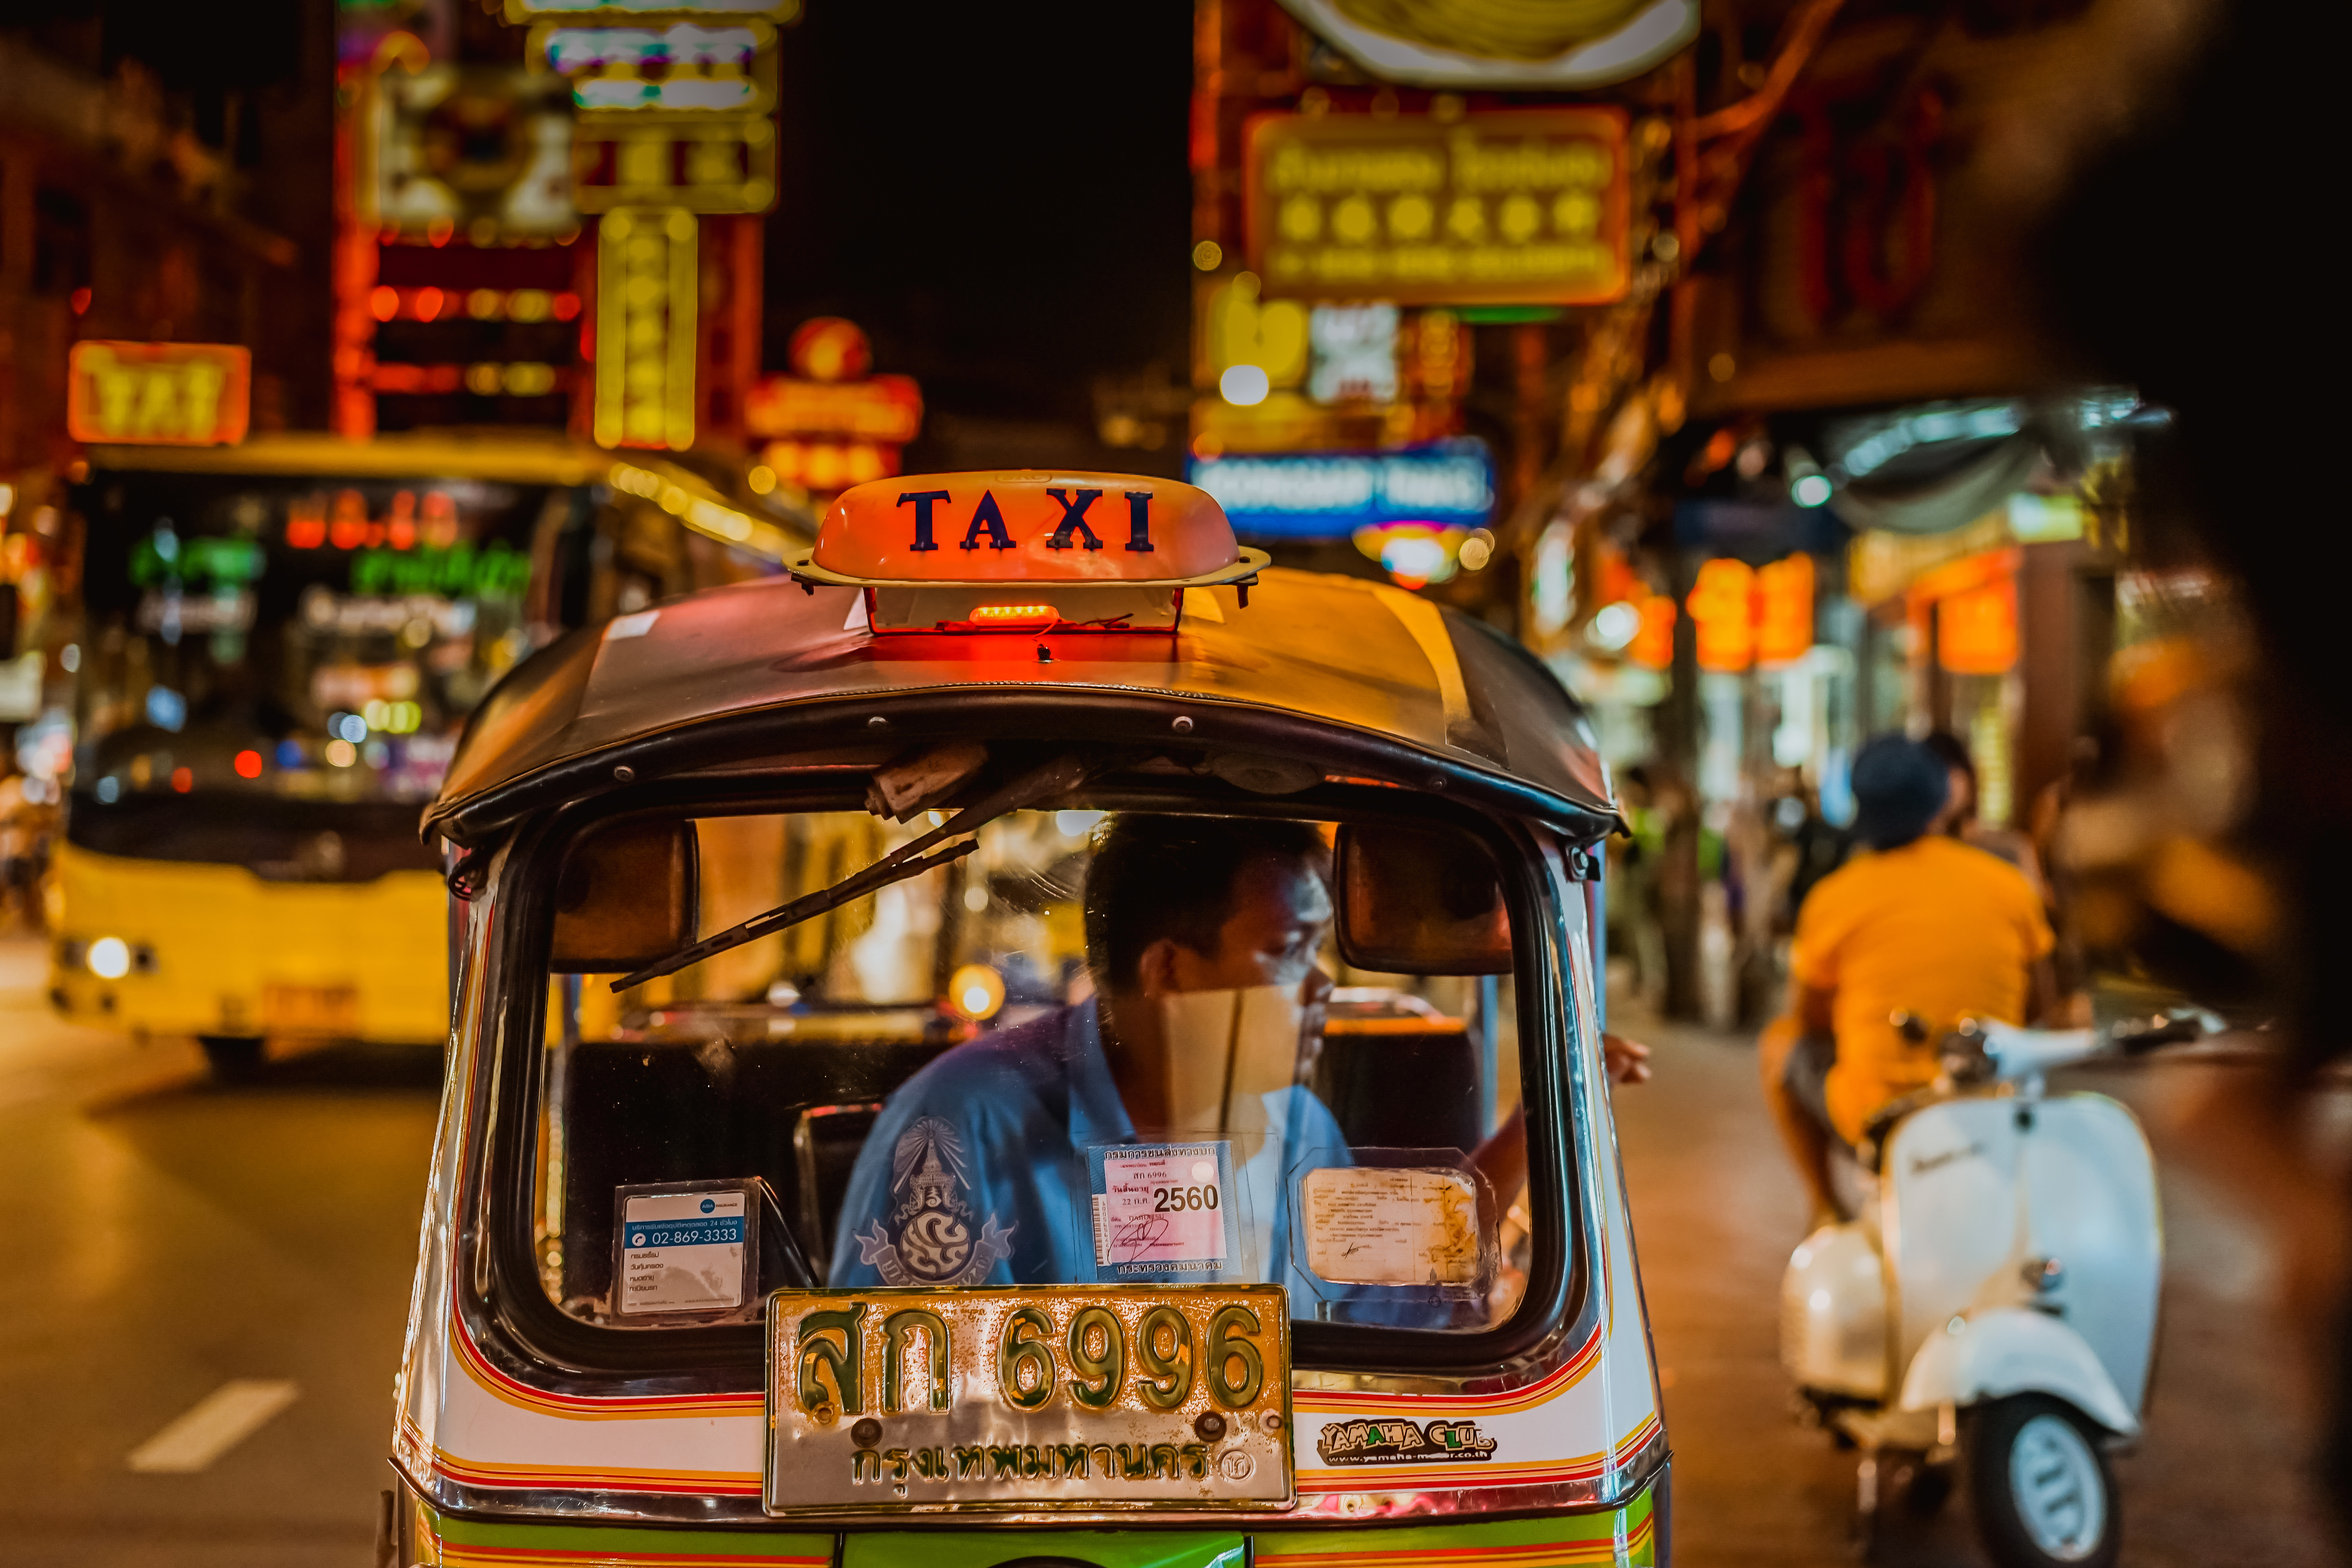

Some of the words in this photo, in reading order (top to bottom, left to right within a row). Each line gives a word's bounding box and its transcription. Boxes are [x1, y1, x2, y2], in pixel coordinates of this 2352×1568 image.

[896, 488, 1154, 552] TAXI
[1104, 1145, 1217, 1159] กรมการขนส่งทางบก
[1154, 1185, 1218, 1212] 2560
[652, 1228, 737, 1245] 02-869-3333
[1117, 1260, 1223, 1275] กระทรวงคมนาคม
[796, 1302, 950, 1416] สก
[997, 1303, 1265, 1412] 6996
[1319, 1422, 1425, 1454] YAMAHA
[851, 1441, 1210, 1498] กรุงเทพมหานคร
